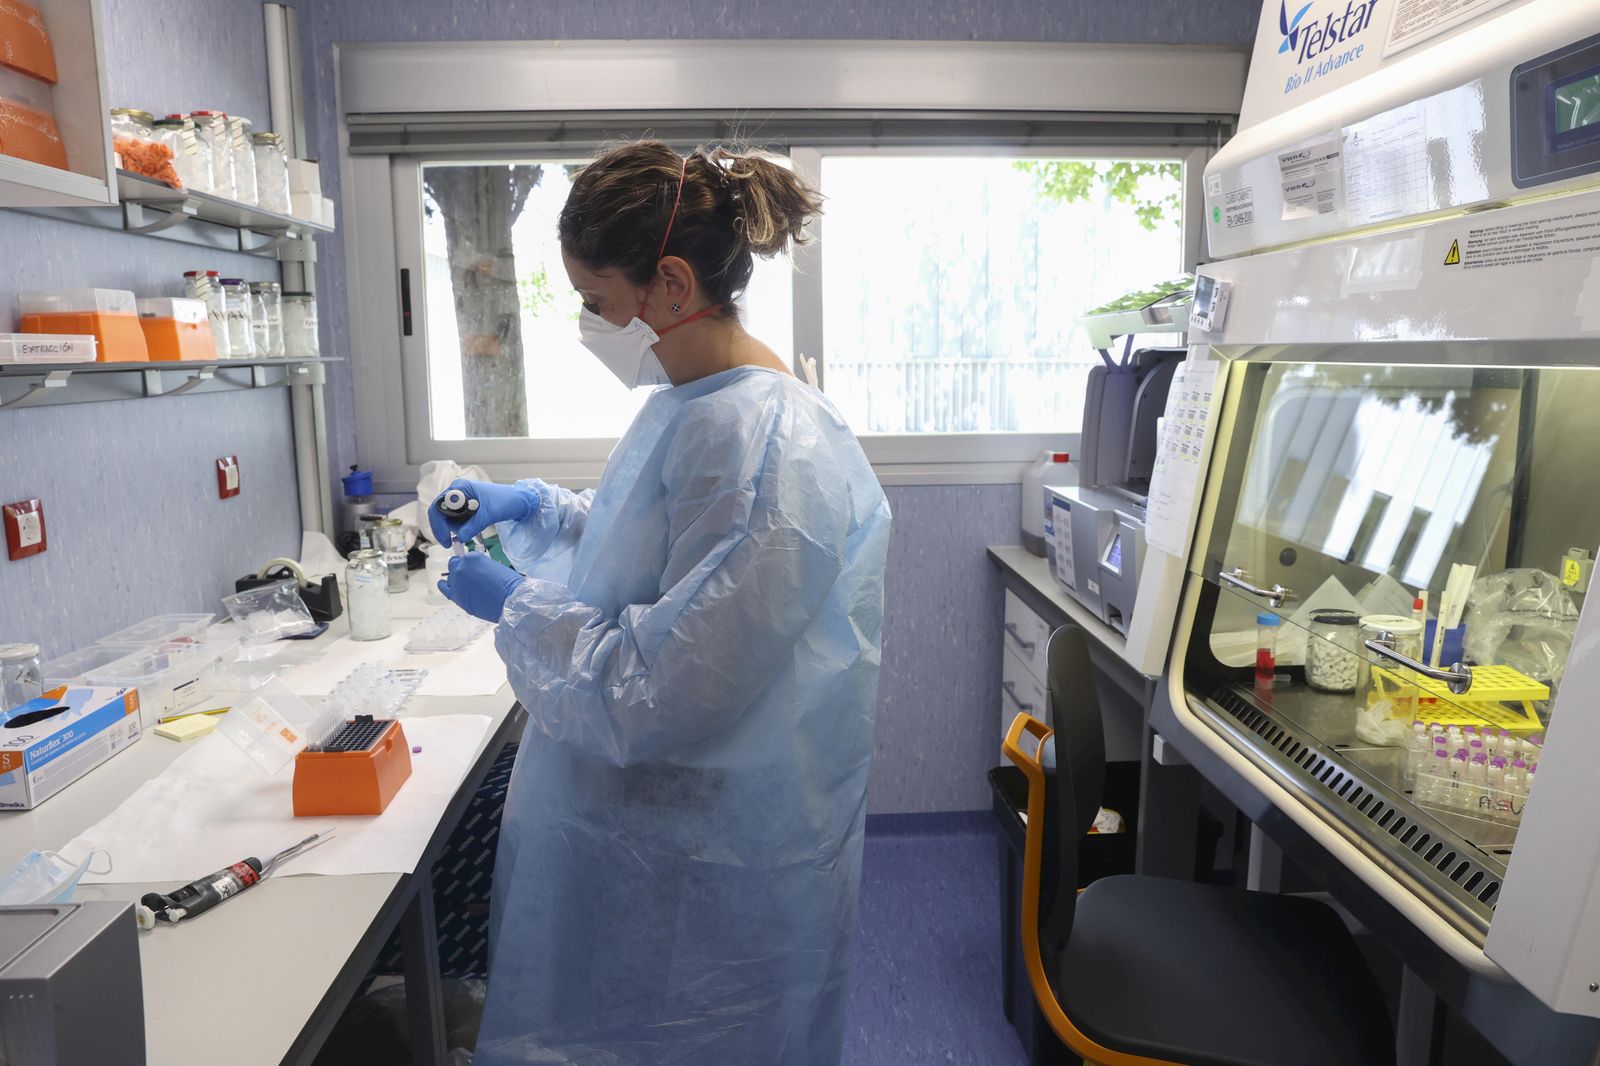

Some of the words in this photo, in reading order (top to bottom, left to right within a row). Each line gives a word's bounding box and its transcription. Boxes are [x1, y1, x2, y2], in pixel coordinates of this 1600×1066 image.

[1298, 0, 1378, 64] Telstar
[1284, 73, 1301, 94] Bio
[1303, 65, 1314, 85] II
[1314, 44, 1364, 80] Advance
[62, 729, 74, 742] 300
[2, 753, 10, 765] S
